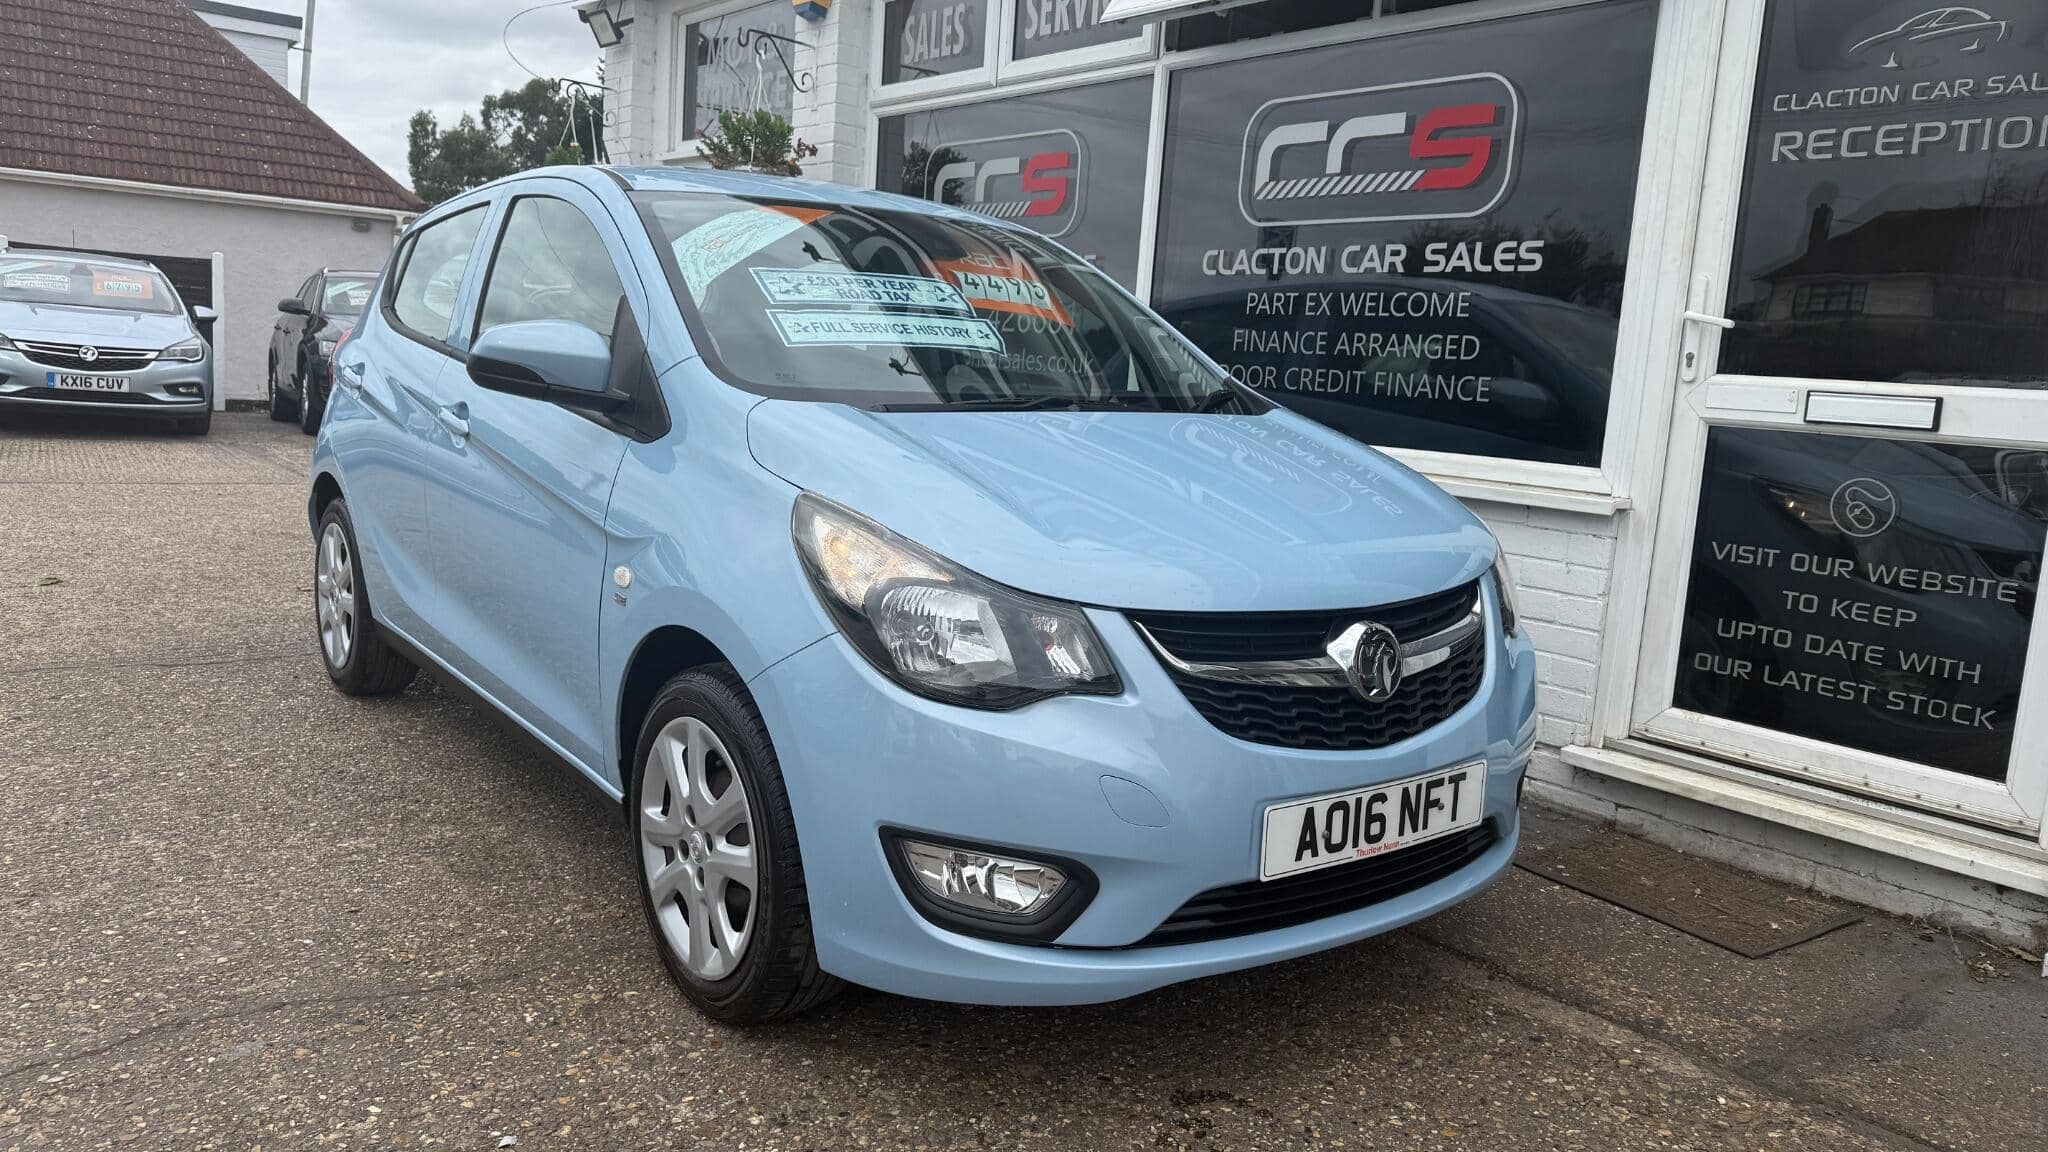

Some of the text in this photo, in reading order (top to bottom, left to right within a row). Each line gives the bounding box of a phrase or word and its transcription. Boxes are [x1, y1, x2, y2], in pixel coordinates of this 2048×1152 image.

[903, 3, 966, 64] SALES
[1025, 0, 1110, 39] SERVI
[1773, 85, 1900, 112] CLACTON
[1912, 78, 1974, 100] CAR
[1202, 239, 1546, 276] CLACTON CAR SALES
[808, 276, 920, 293] £20 PER YEAR
[839, 288, 913, 303] ROAD TAX
[963, 272, 1046, 300] 4495
[1246, 291, 1471, 318] PART EX WELCOME
[811, 321, 971, 339] FULL SERVICE HISTORY
[1232, 328, 1481, 361] FINANCE ARRANGED
[60, 375, 124, 390] KX16 CUV
[1284, 367, 1367, 395] CREDIT
[1374, 371, 1492, 403] FINANCE
[1711, 541, 2019, 603] VISIT OUR WEBSITE
[1782, 590, 1918, 628] TO KEEP
[1717, 618, 1982, 684] UPTO DATE WITH
[1694, 652, 1999, 731] OUR LATEST STOCK
[1294, 772, 1467, 862] AO16 NFT
